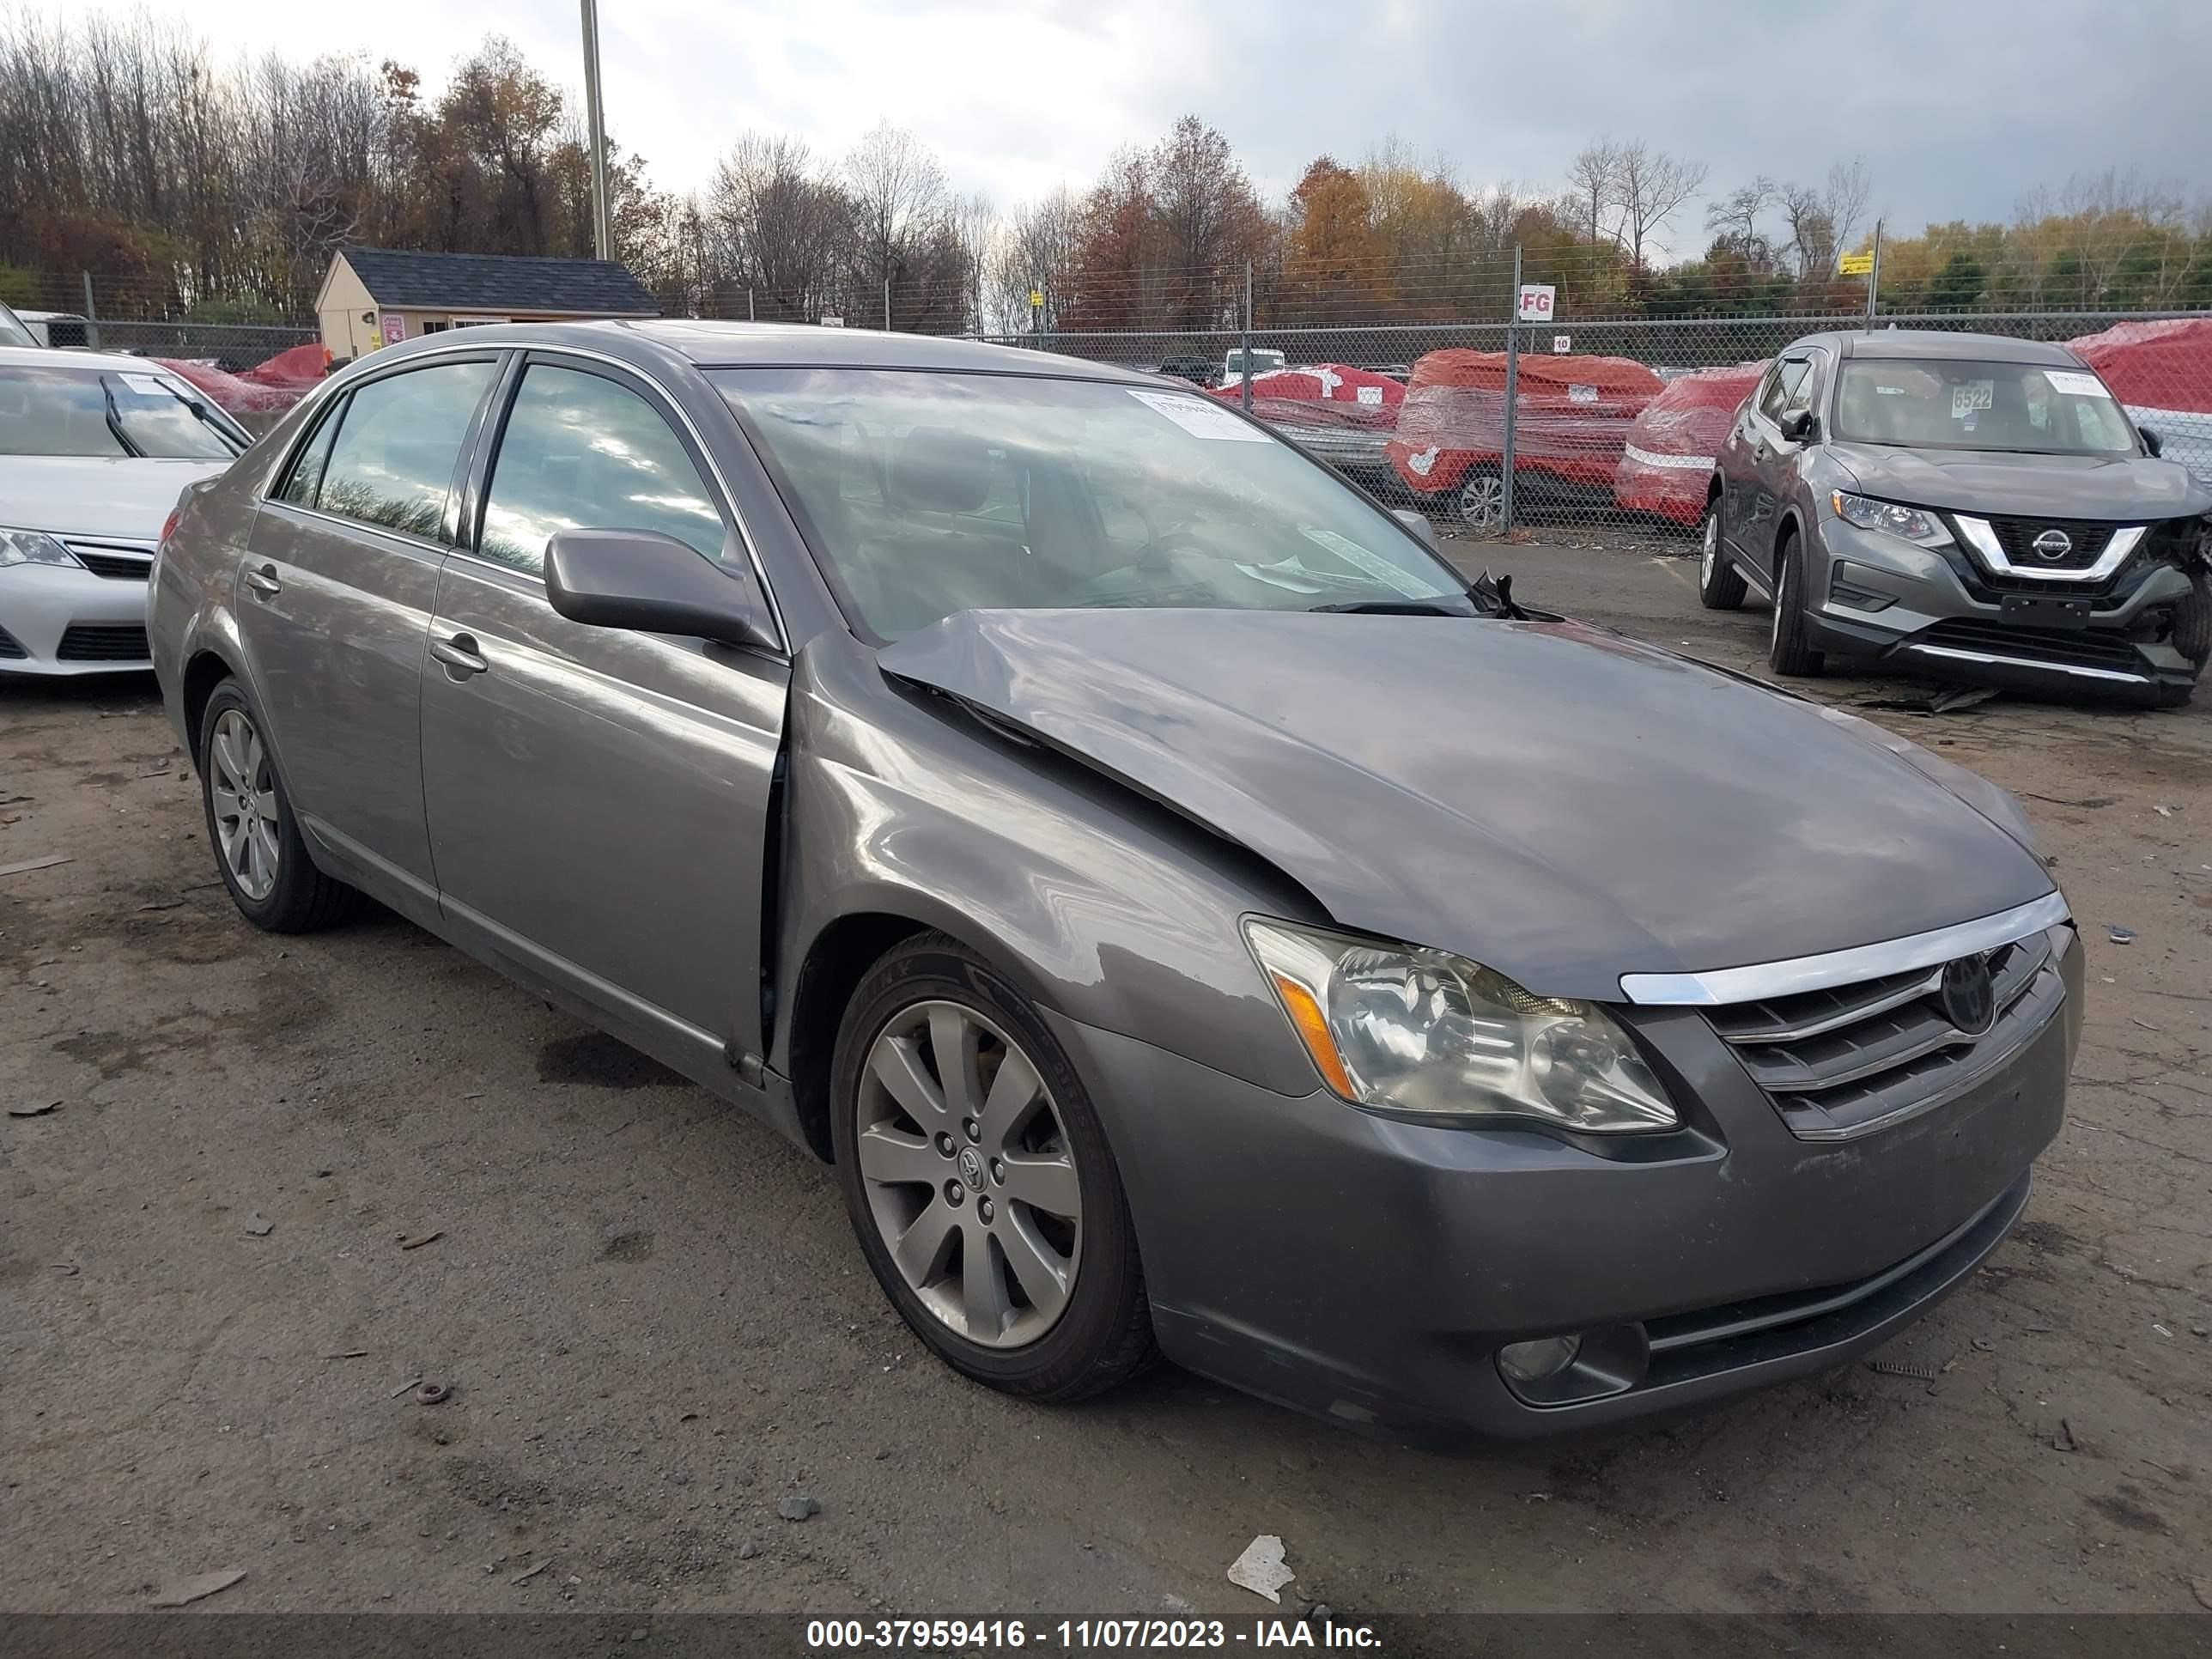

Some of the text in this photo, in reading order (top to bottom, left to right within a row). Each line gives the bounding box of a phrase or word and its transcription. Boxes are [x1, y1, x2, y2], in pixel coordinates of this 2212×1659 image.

[1522, 293, 1551, 312] FG
[1555, 339, 1568, 349] 10
[1954, 388, 1991, 409] 6522
